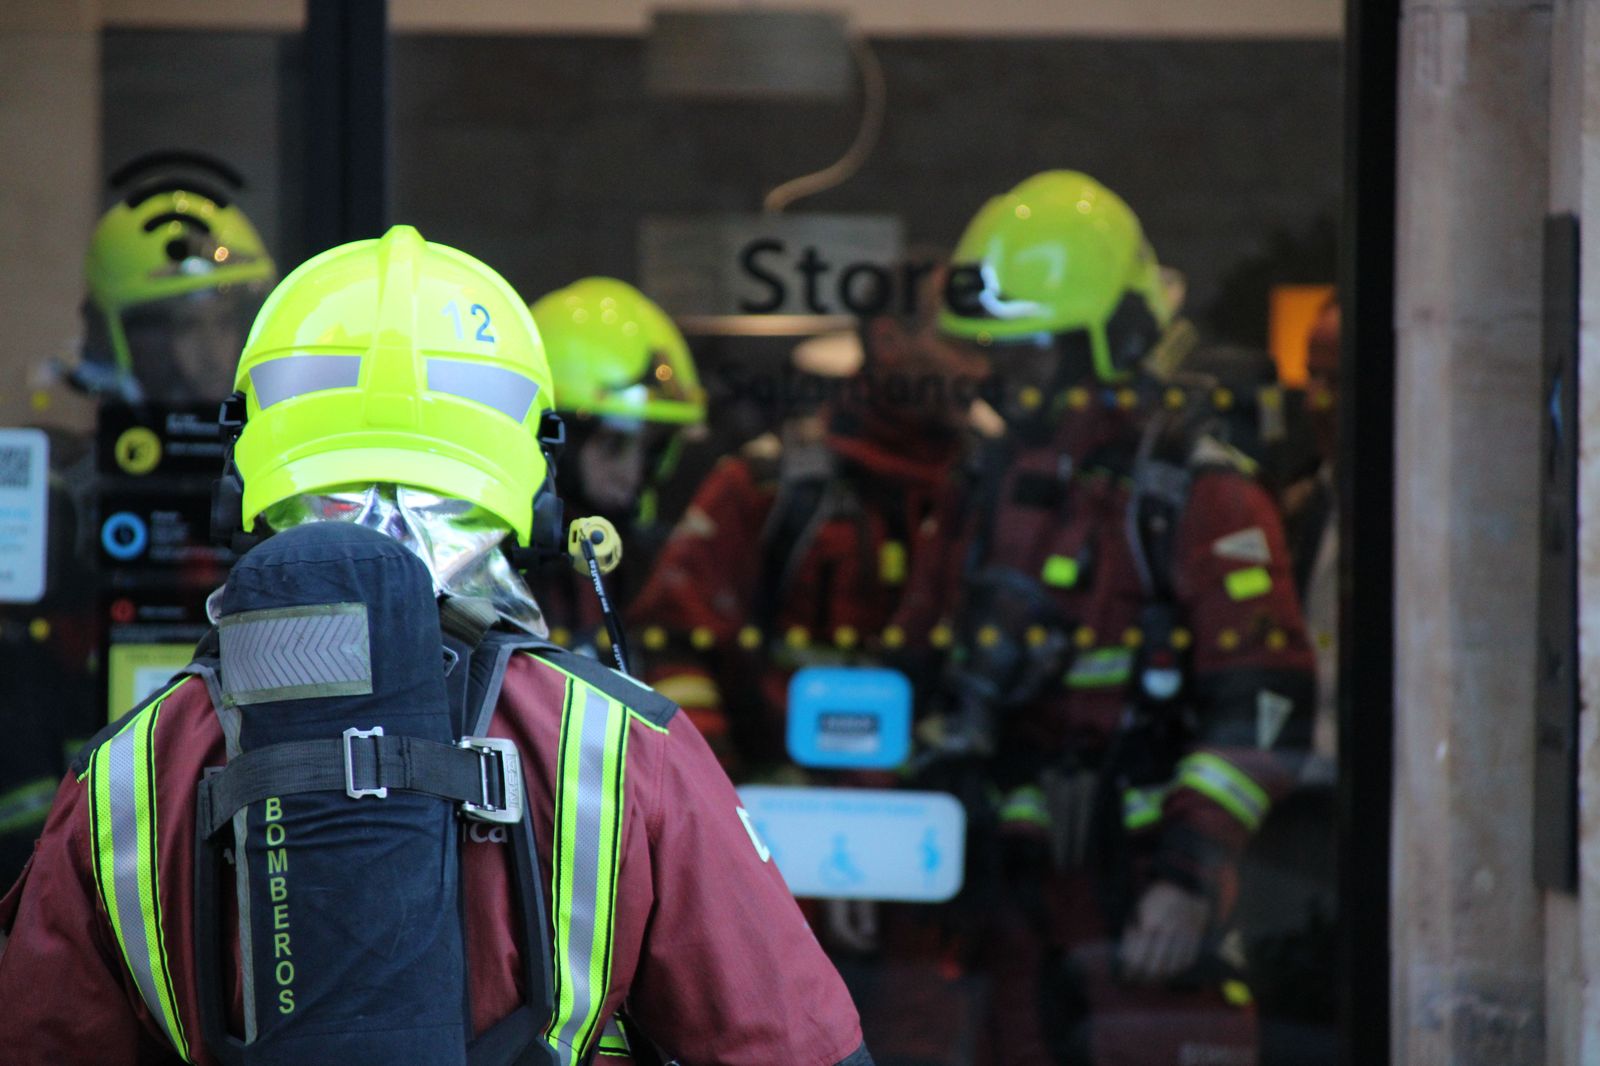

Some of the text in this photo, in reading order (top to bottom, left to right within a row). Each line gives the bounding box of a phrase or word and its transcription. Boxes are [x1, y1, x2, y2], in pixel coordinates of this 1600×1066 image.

[738, 238, 988, 318] Store
[441, 299, 495, 343] 12
[265, 797, 295, 1015] BOMBEROS
